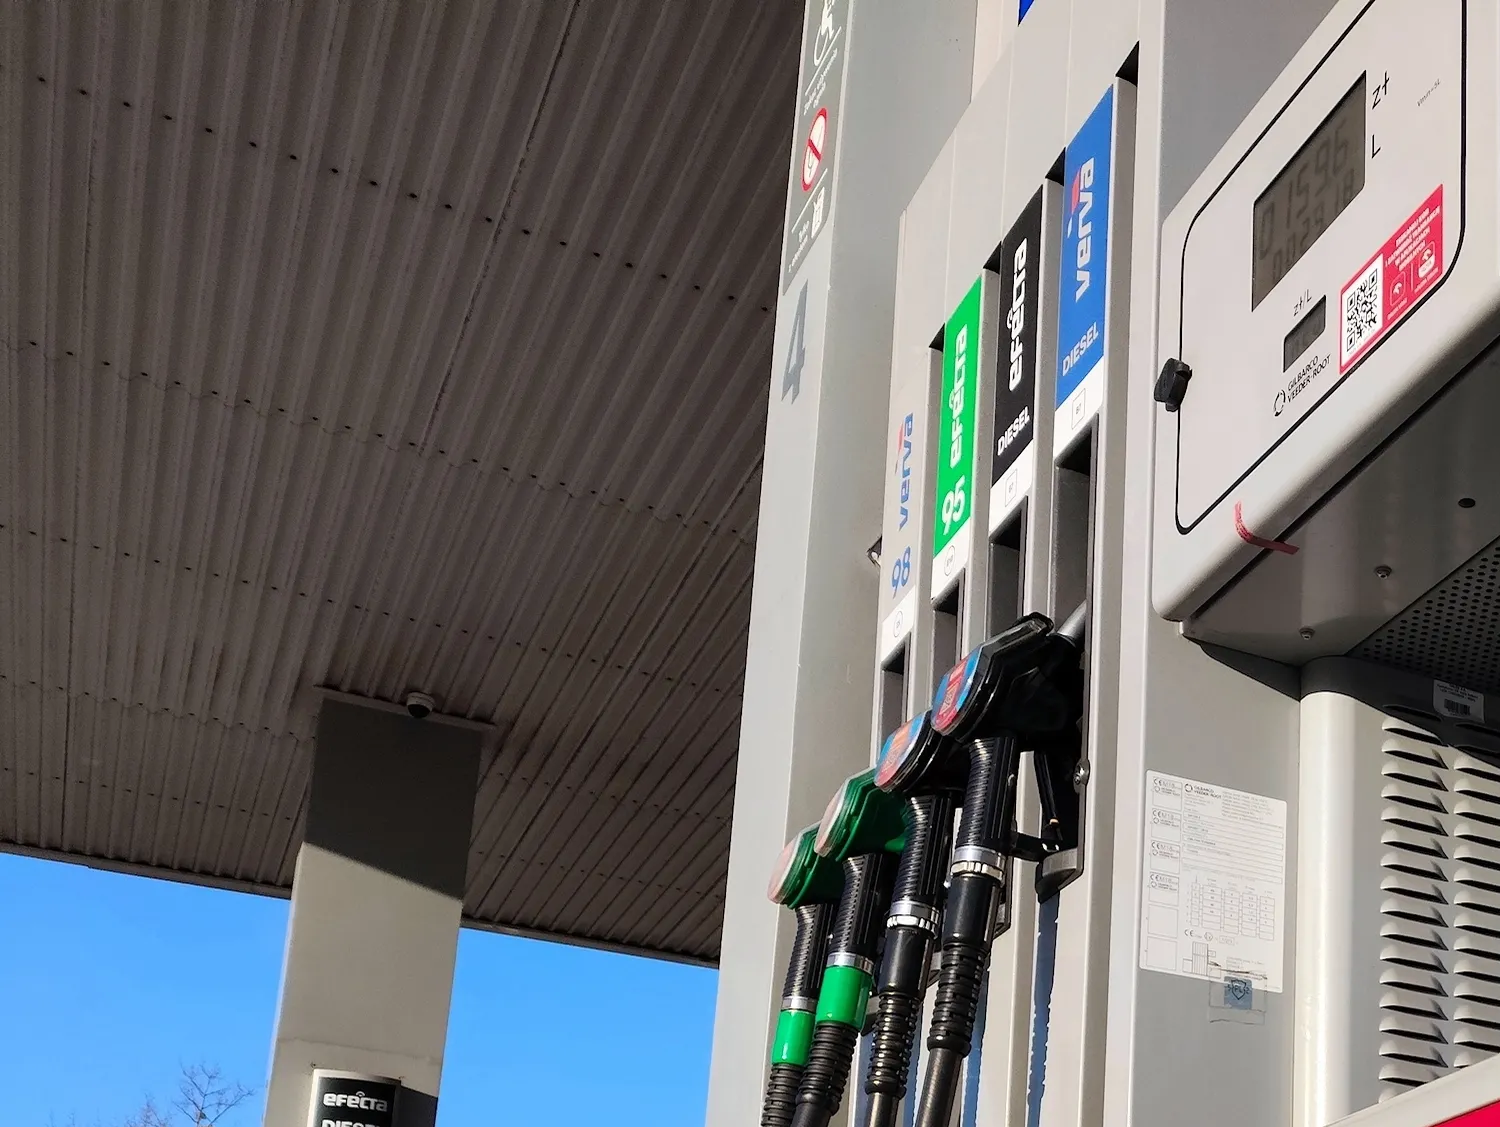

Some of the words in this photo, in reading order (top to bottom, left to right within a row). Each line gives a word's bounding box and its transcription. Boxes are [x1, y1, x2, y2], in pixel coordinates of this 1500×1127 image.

[1371, 133, 1382, 159] L
[780, 277, 809, 405] 4
[1062, 321, 1099, 377] DIESEL
[1287, 355, 1319, 393] GILBARCO
[997, 405, 1030, 456] DIESEL
[941, 474, 965, 536] 95
[891, 546, 911, 600] 98
